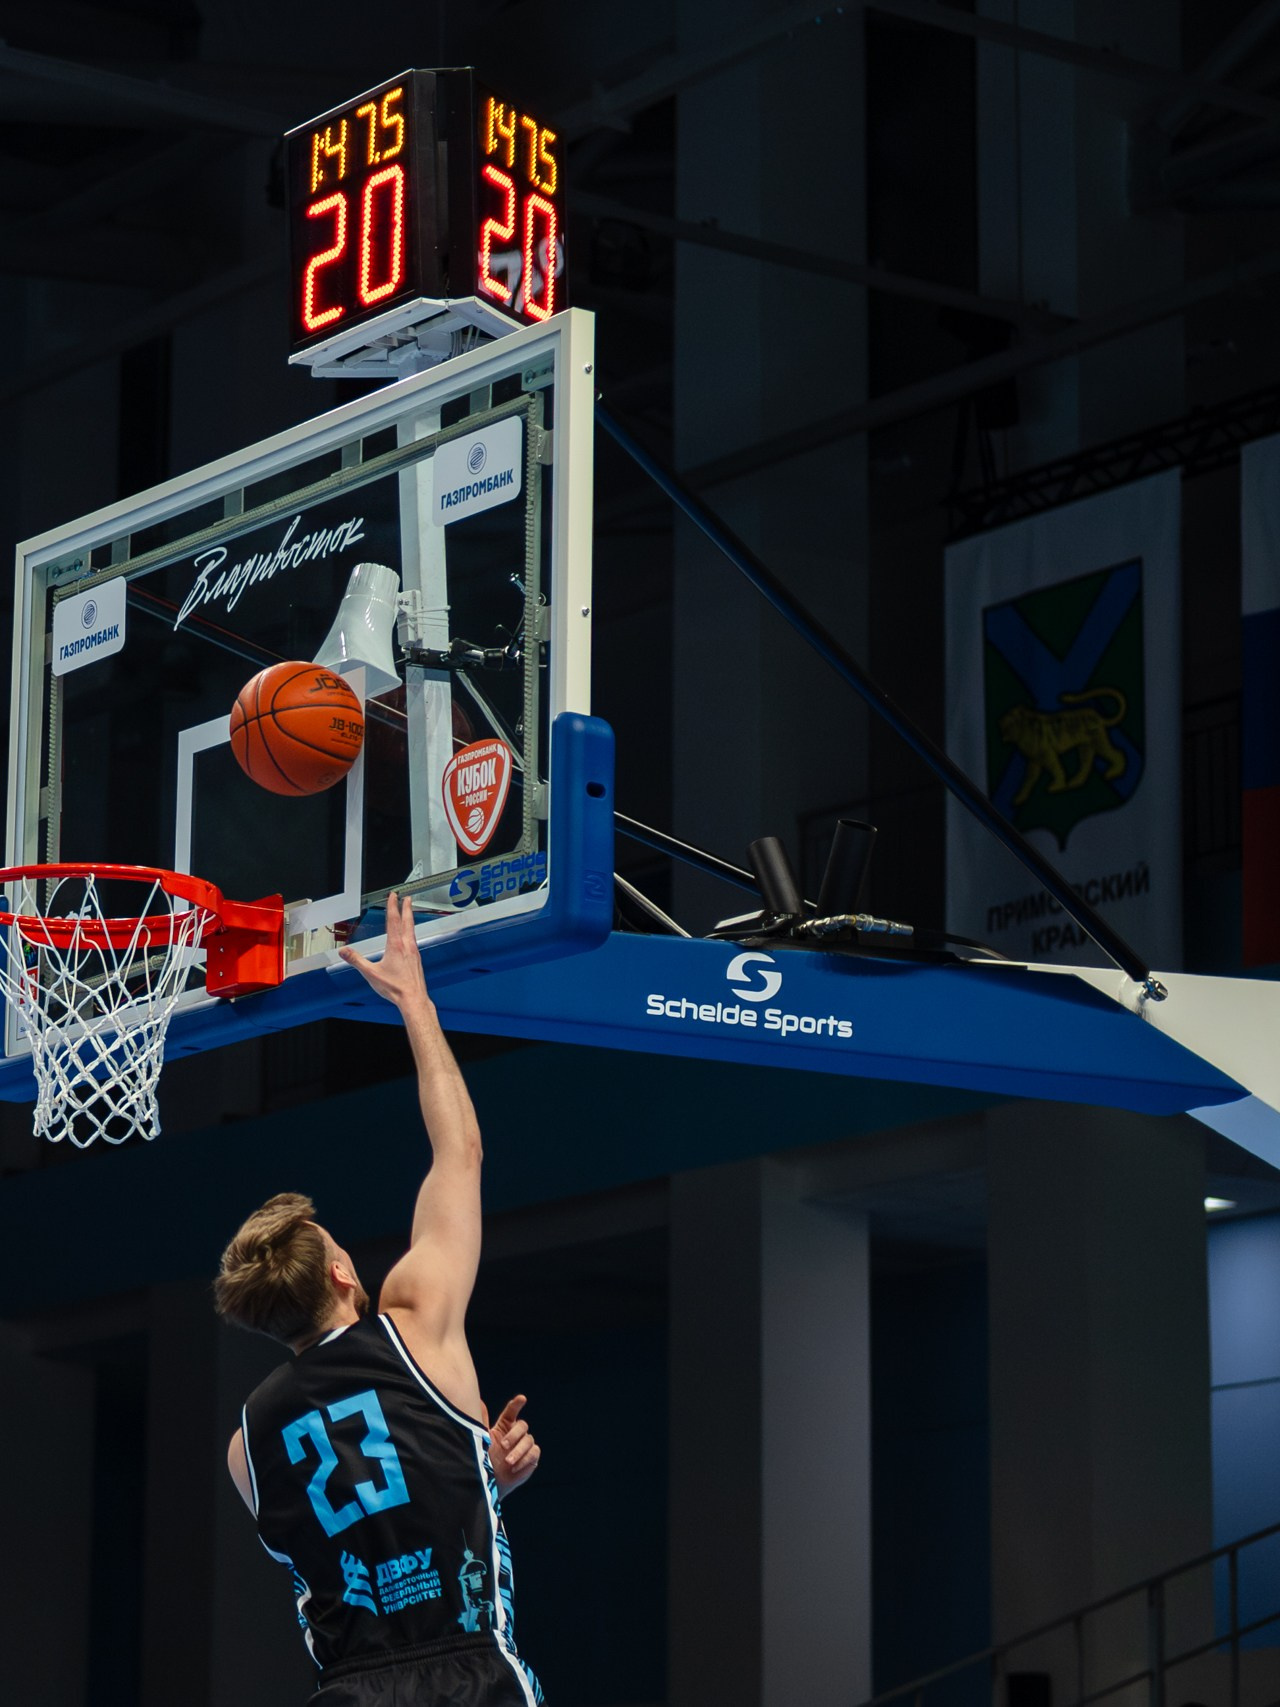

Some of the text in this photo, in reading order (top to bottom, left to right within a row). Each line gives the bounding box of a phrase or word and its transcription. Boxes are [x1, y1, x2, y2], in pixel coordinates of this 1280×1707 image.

[304, 164, 404, 332] 20
[482, 165, 557, 322] 20
[440, 468, 514, 510] ГАЗПРОМБАНК
[173, 515, 365, 632] Владивосток
[60, 624, 119, 661] ГАЗПРОМБАНК
[457, 743, 497, 765] ГАЗПРОМБАНК
[457, 757, 497, 798] КУБОК
[465, 793, 488, 808] РОССИИ
[479, 868, 546, 901] Sports
[480, 851, 547, 882] Schelde
[646, 994, 853, 1038] Schelde Sports
[281, 1388, 411, 1539] 23
[376, 1547, 433, 1587] ДВФУ
